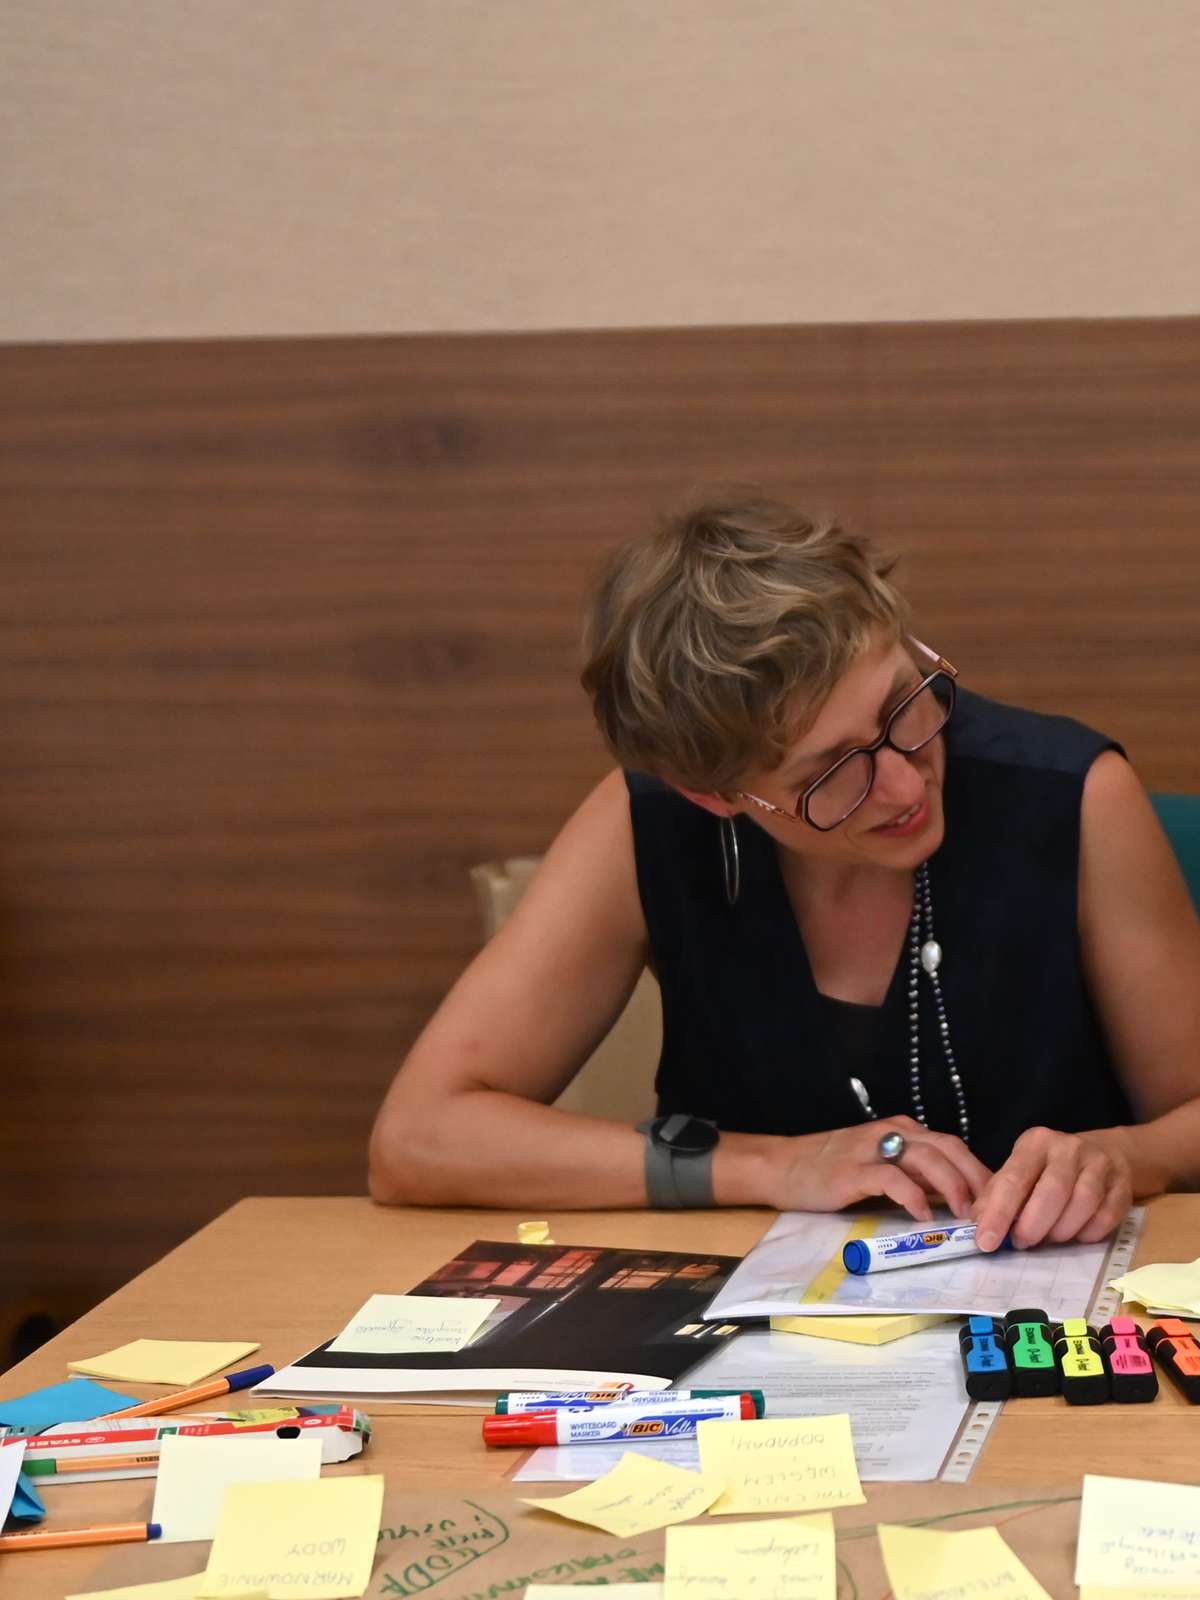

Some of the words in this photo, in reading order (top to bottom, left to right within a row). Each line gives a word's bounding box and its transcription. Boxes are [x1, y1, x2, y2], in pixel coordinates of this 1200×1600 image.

[571, 1421, 617, 1431] WHITEBOARD
[632, 1423, 661, 1433] BIC
[571, 1430, 601, 1438] MARKER
[287, 1538, 347, 1558] WODY
[218, 1571, 353, 1587] MARNOWANIE
